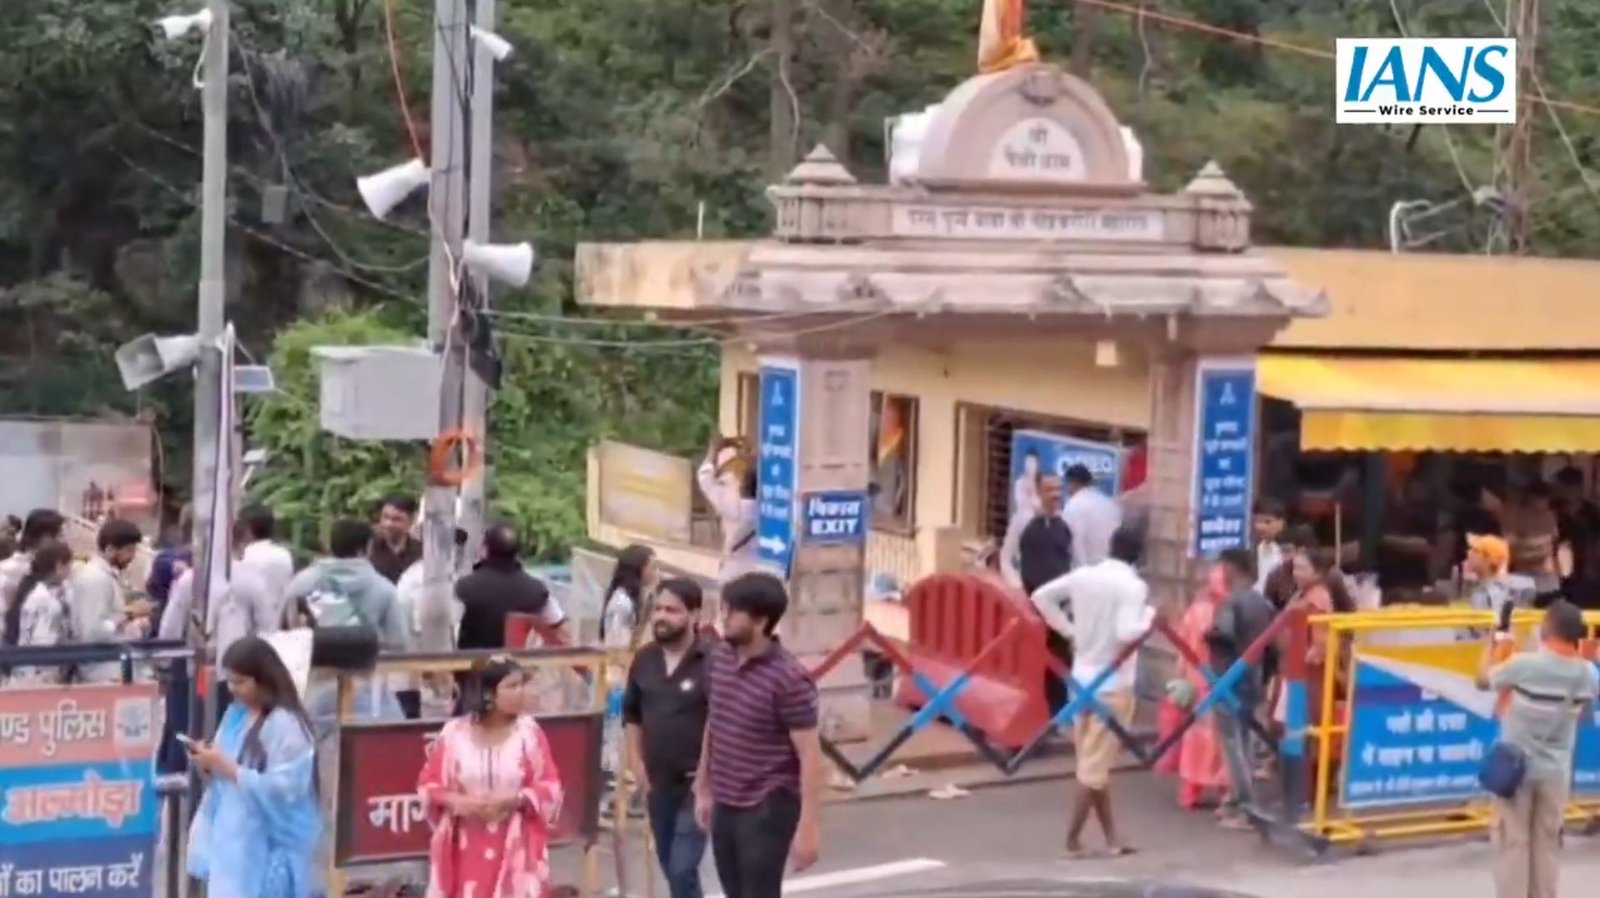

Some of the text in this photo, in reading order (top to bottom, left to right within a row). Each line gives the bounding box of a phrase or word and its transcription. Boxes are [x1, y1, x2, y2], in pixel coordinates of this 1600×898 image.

[811, 518, 859, 535] EXIT
[38, 698, 106, 756] पुलिस
[16, 868, 43, 894] का
[49, 864, 104, 893] पालन
[107, 852, 143, 888] करें
